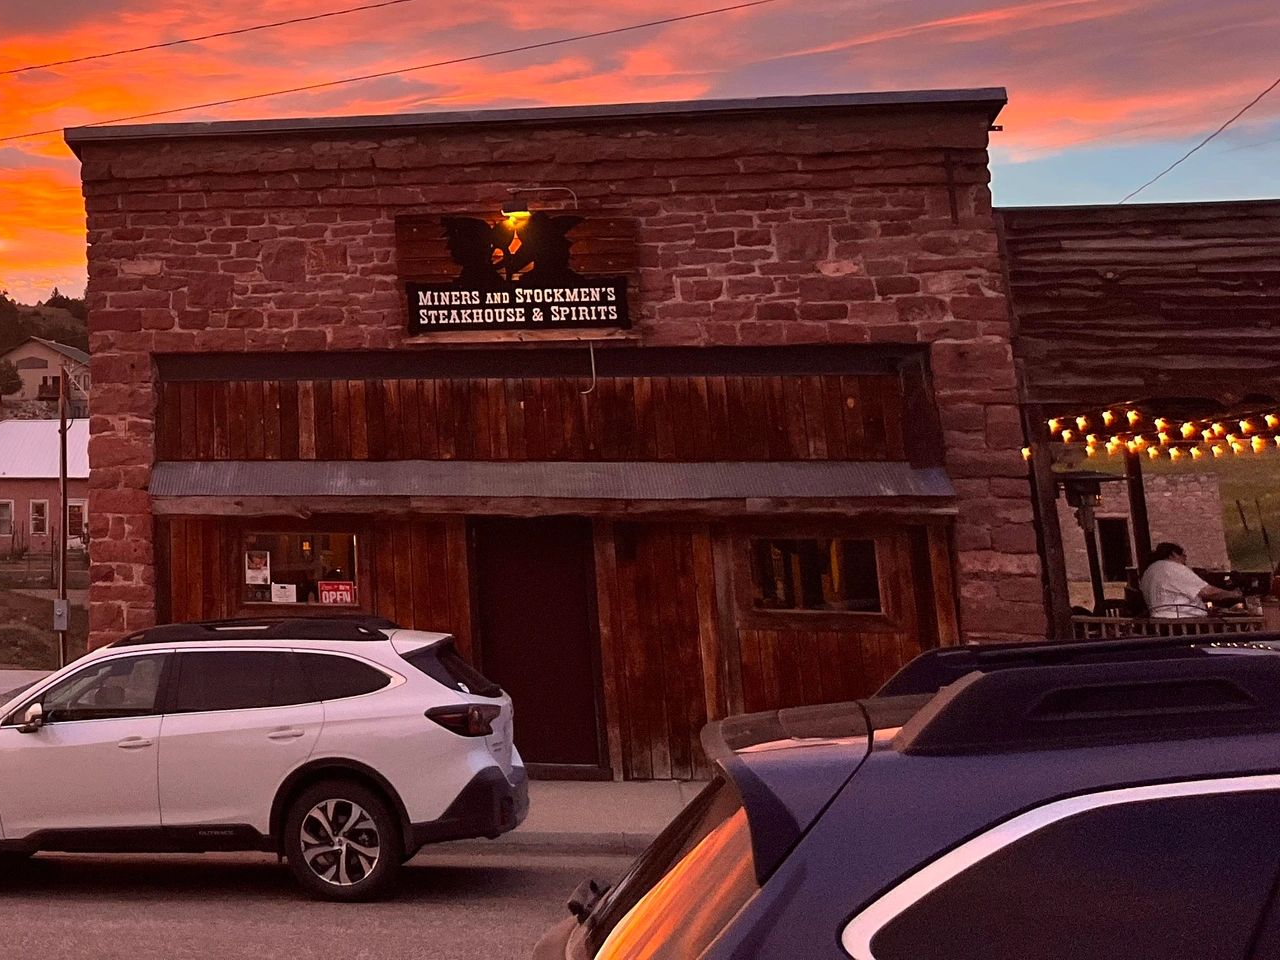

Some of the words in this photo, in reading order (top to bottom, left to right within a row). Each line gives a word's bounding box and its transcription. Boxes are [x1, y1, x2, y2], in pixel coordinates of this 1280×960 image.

[418, 291, 480, 306] MINERS
[485, 292, 510, 304] AND
[515, 287, 616, 303] STOCKMEN'S
[419, 307, 526, 325] STEAKHOUSE
[532, 307, 544, 322] &
[550, 305, 618, 321] SPIRITS
[322, 590, 351, 603] OPEN
